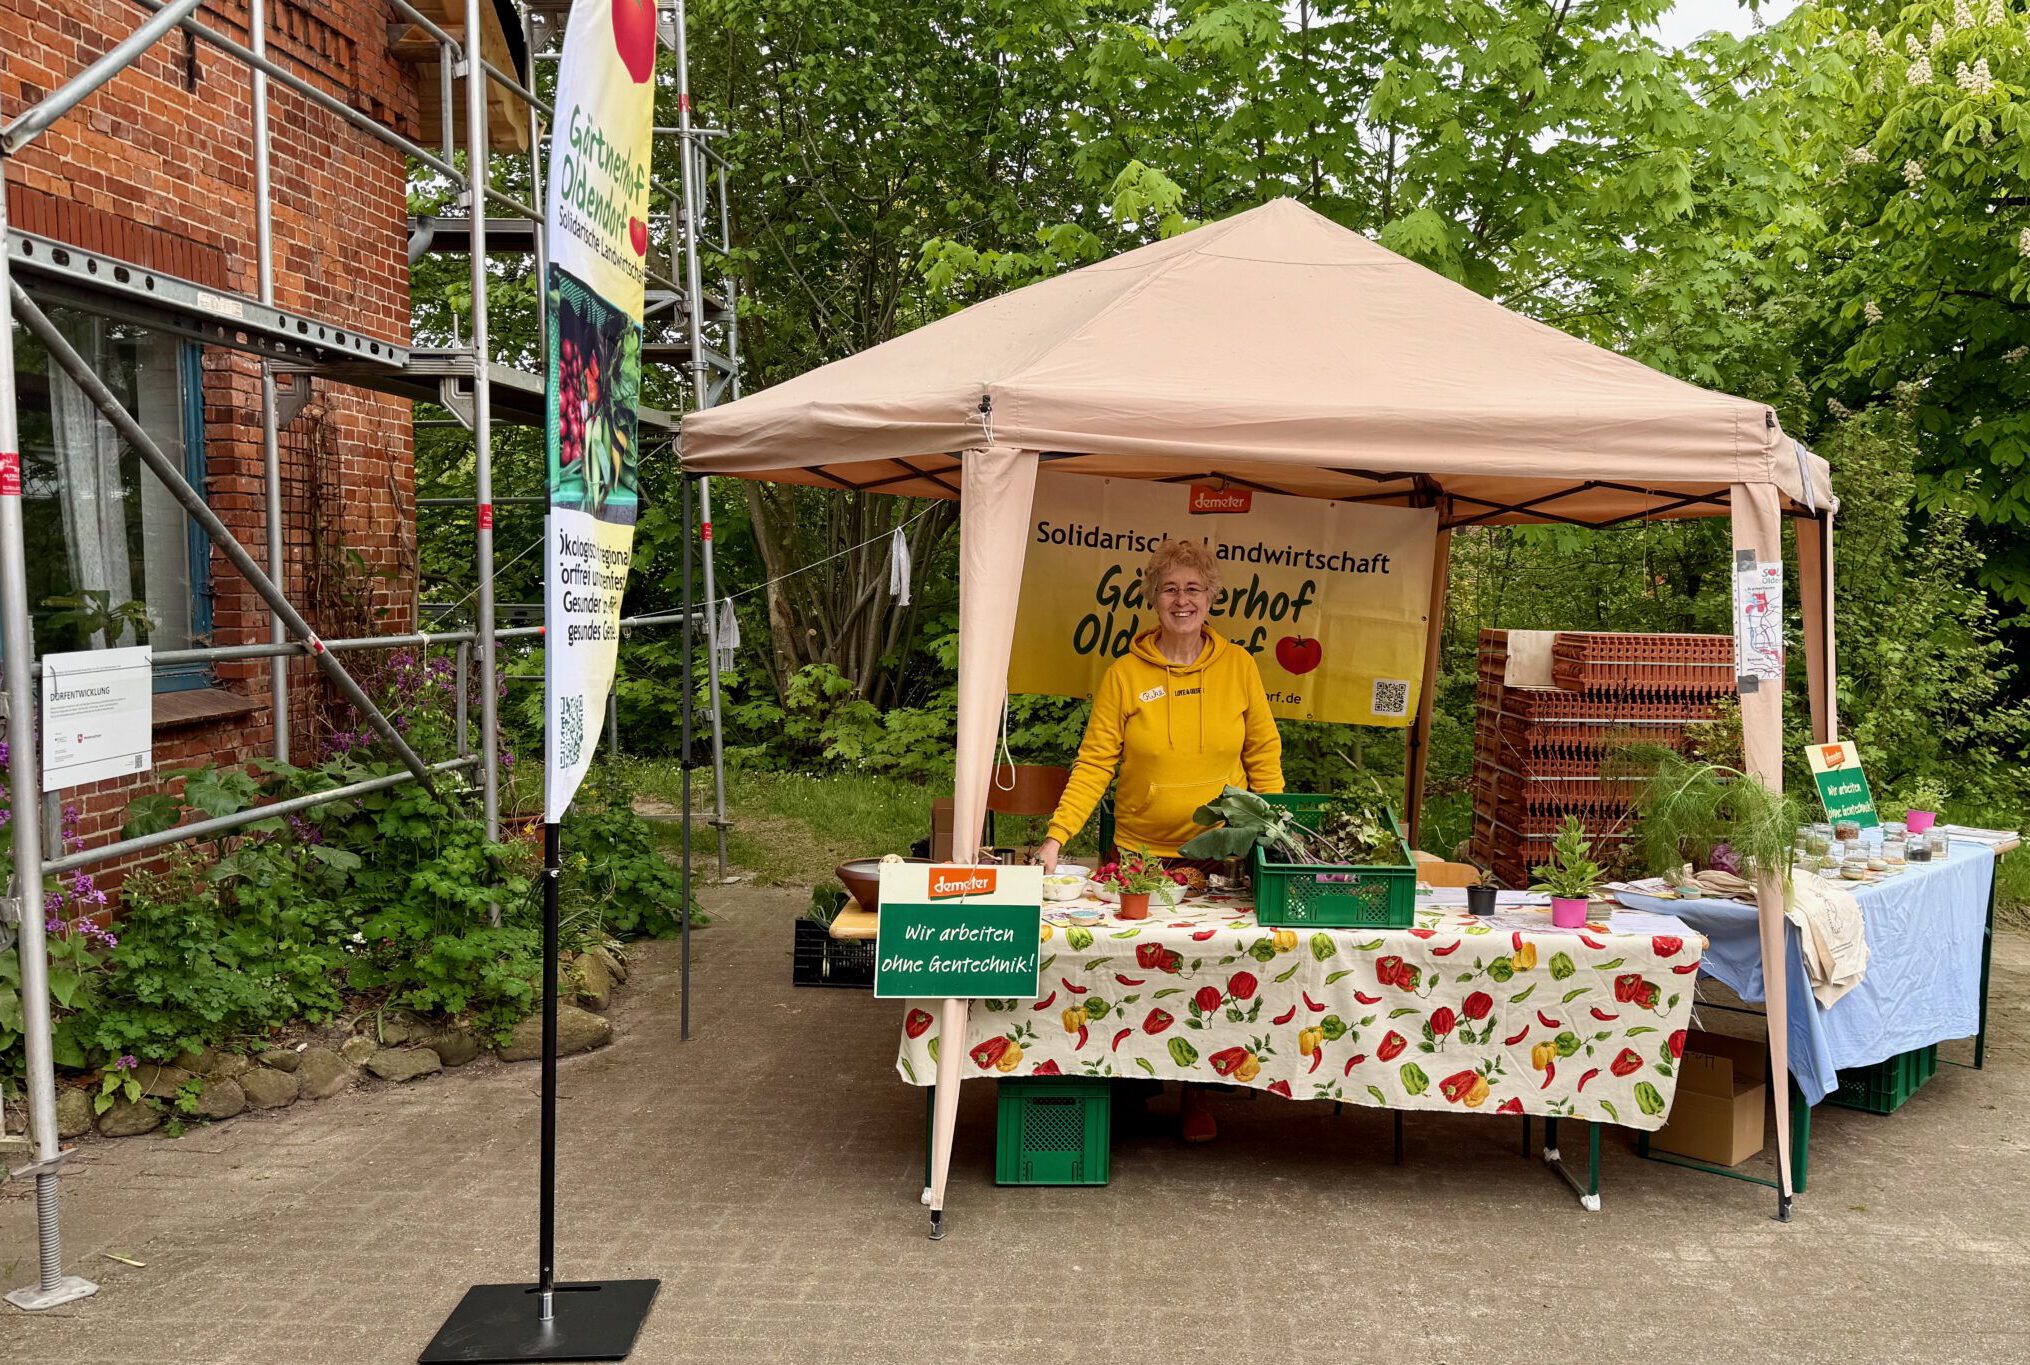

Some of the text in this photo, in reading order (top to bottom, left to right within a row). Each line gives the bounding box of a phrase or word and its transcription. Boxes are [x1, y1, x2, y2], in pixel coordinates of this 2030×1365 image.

[569, 103, 645, 206] Gärtnerhof
[561, 153, 628, 246] Oldendorf
[559, 204, 645, 287] Solidarische Landwirtschaf
[1195, 495, 1245, 509] demeter
[1036, 520, 1391, 575] Solidarisc andwirtschaft
[560, 562, 591, 585] orffrei
[563, 590, 602, 614] Gesunder
[1095, 564, 1317, 624] Gäerhof
[568, 619, 601, 647] gesundes
[49, 686, 111, 702] DORFENTWICKLUNG
[933, 876, 989, 894] demeter
[905, 922, 1015, 943] Wir arbeiten
[881, 953, 1035, 974] ohne Gentechnik!
